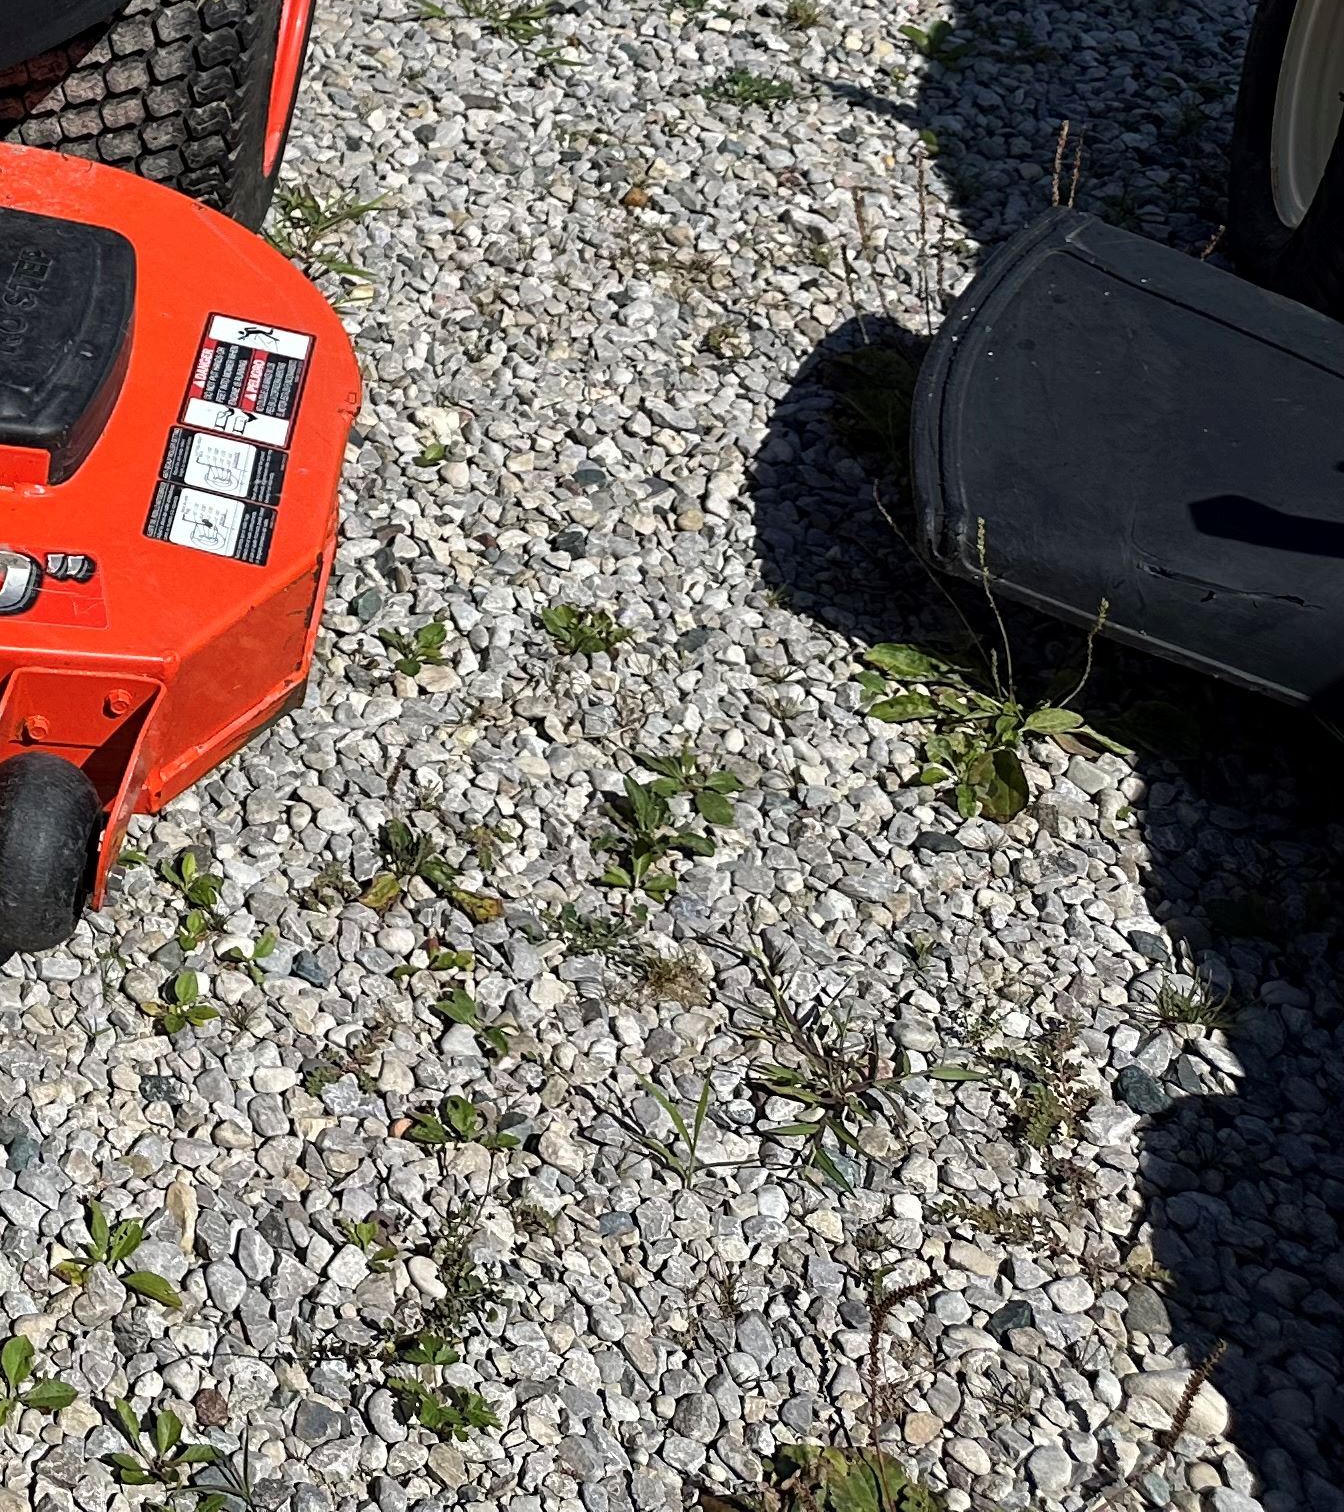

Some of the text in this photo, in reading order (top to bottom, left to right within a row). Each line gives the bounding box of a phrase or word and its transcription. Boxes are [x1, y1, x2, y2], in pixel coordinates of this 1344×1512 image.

[0, 245, 55, 311] STEP
[194, 348, 214, 381] DANGER
[246, 359, 266, 393] PELIGRO
